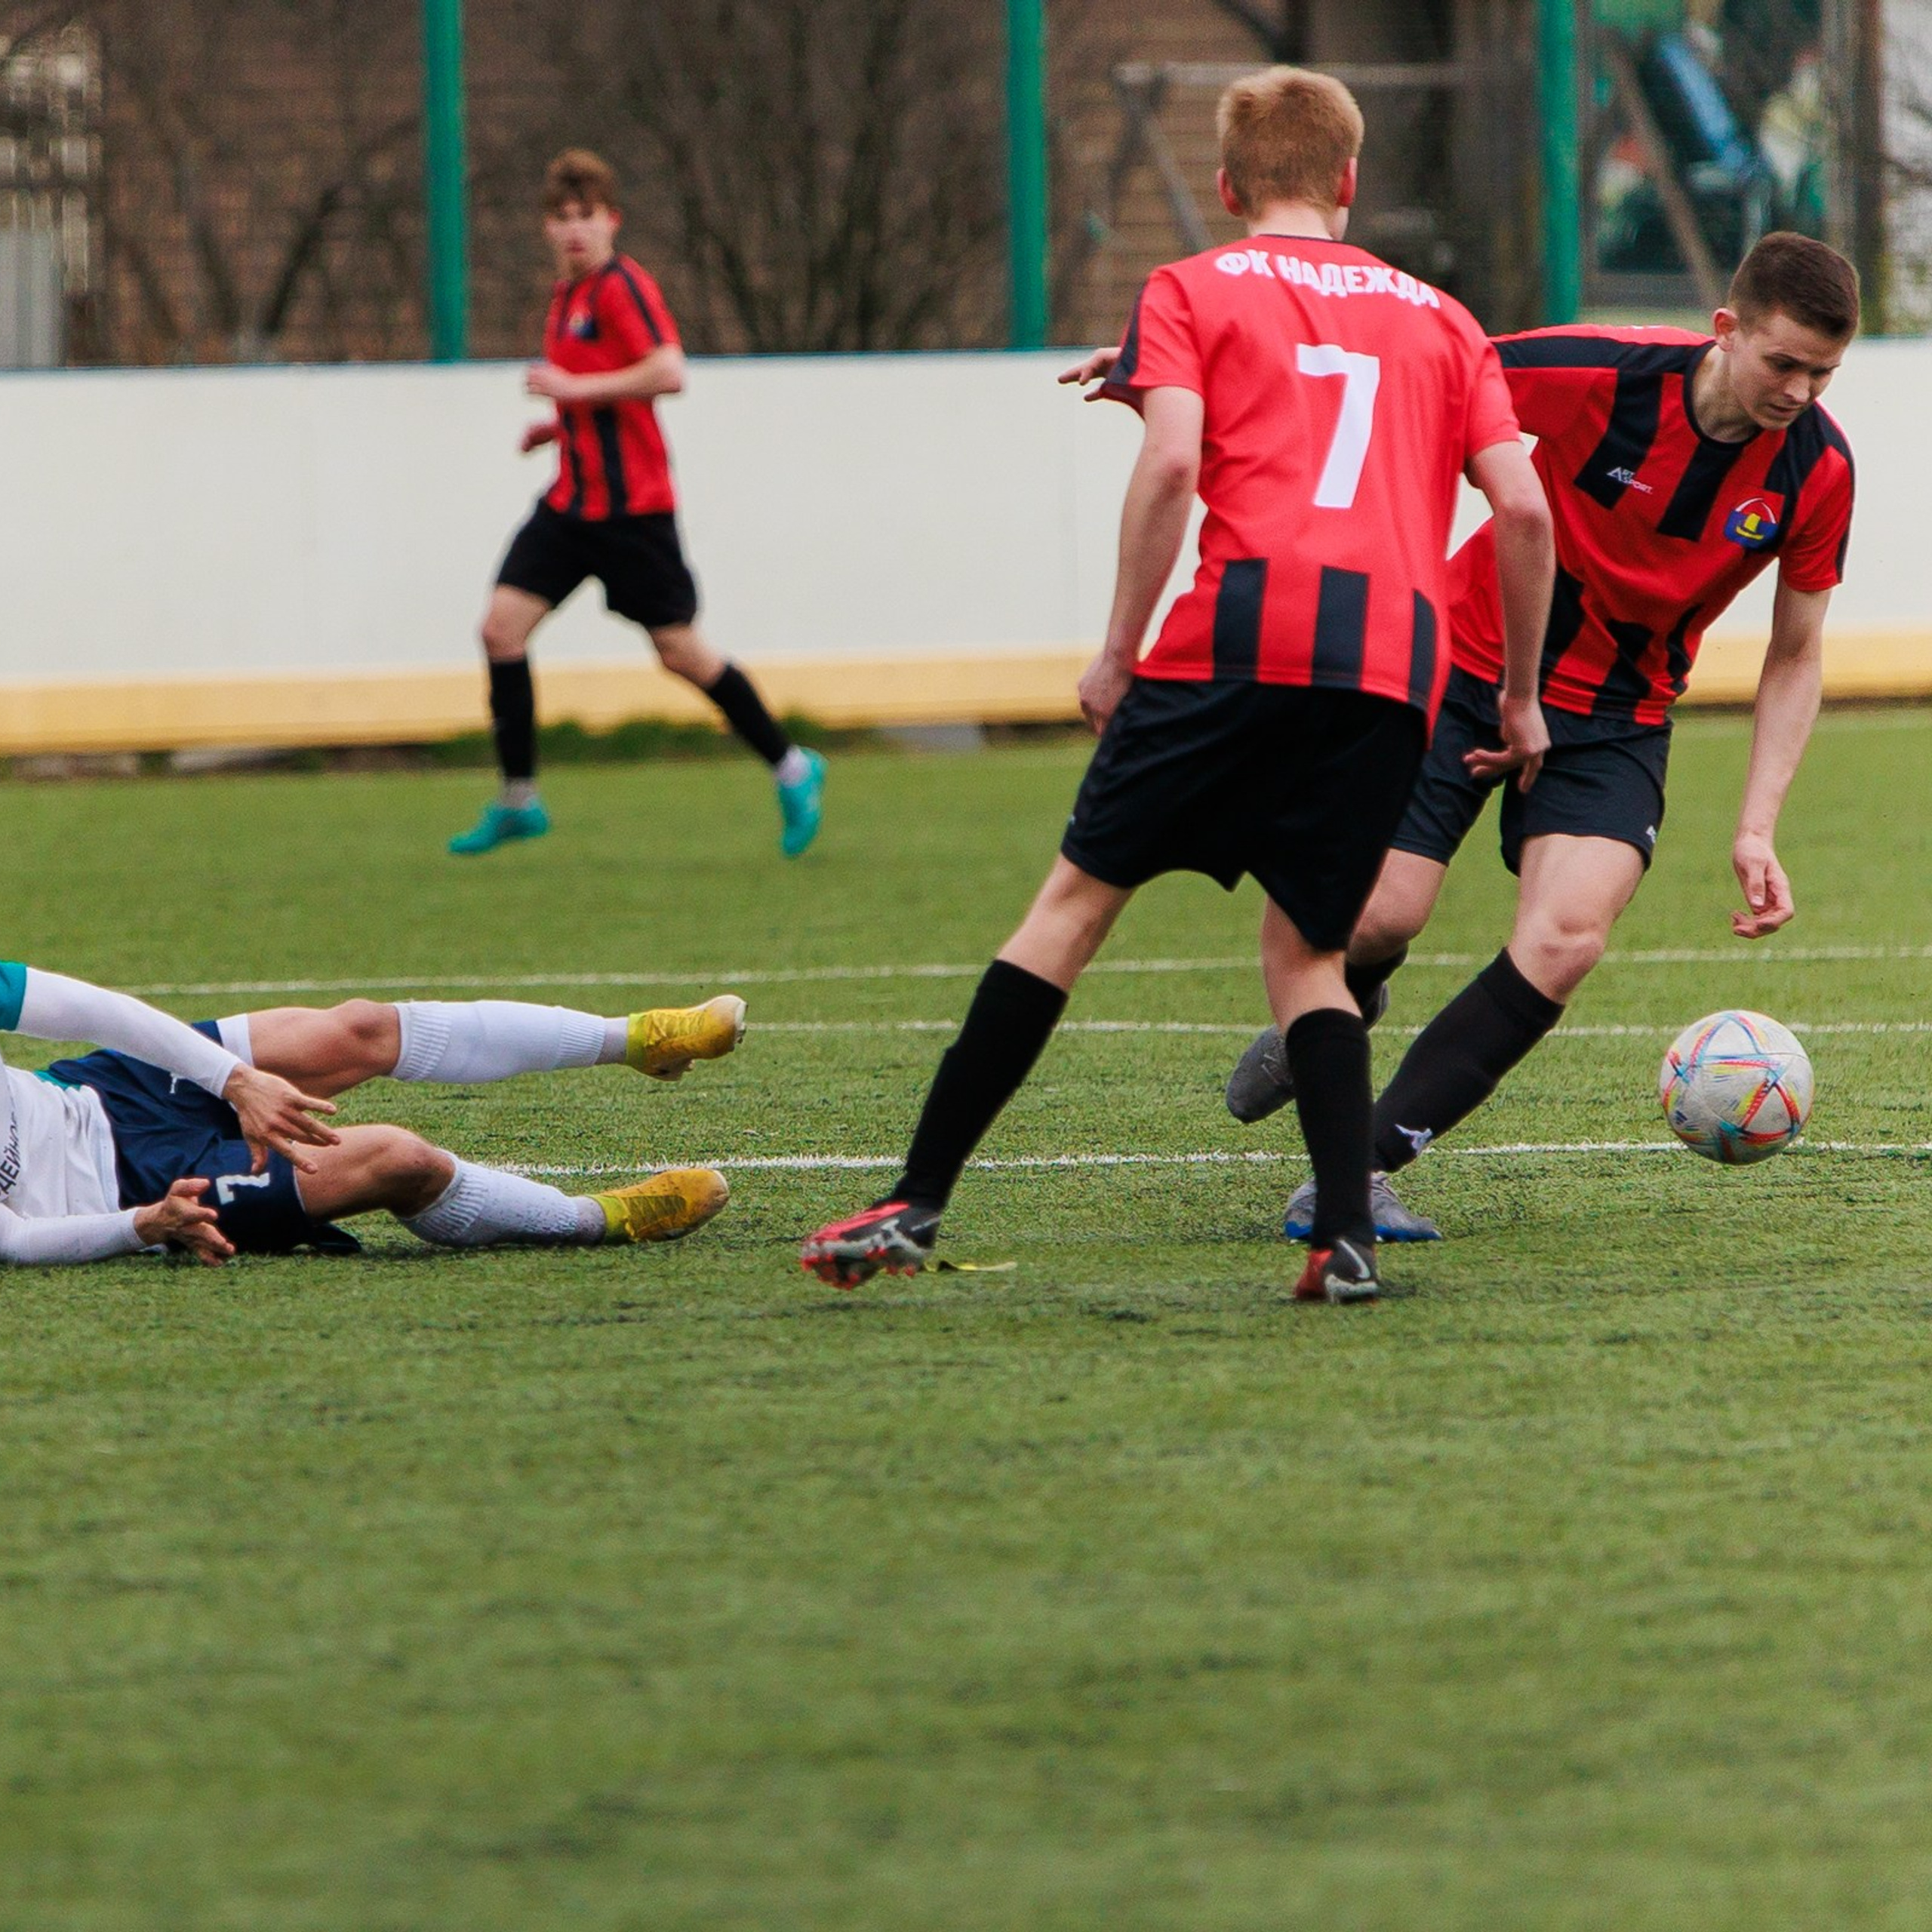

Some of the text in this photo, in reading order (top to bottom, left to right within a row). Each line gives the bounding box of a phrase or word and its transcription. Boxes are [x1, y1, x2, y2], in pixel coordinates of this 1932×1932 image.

[1214, 249, 1441, 309] ФК НАДЕЖДА
[1296, 343, 1380, 509] 7
